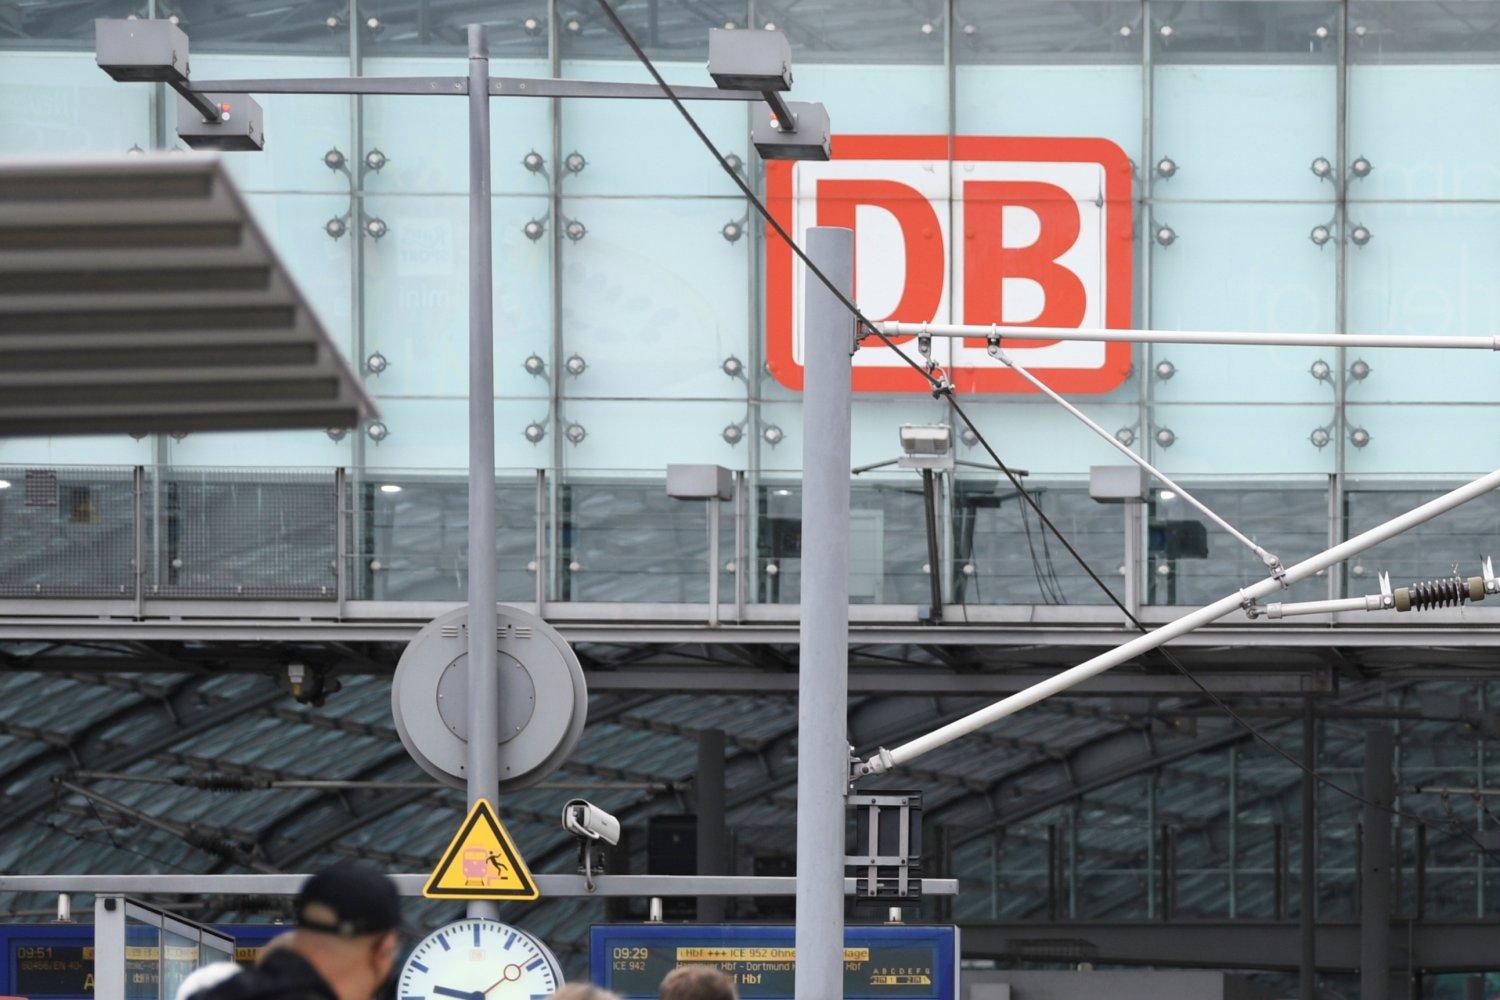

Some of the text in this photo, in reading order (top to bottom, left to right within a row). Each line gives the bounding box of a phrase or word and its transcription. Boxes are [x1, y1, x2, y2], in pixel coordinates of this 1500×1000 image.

[816, 179, 1087, 349] DB
[613, 947, 649, 960] 09:29
[731, 949, 748, 957] ICE
[746, 962, 790, 971] Dortmund
[742, 974, 762, 984] Hbf
